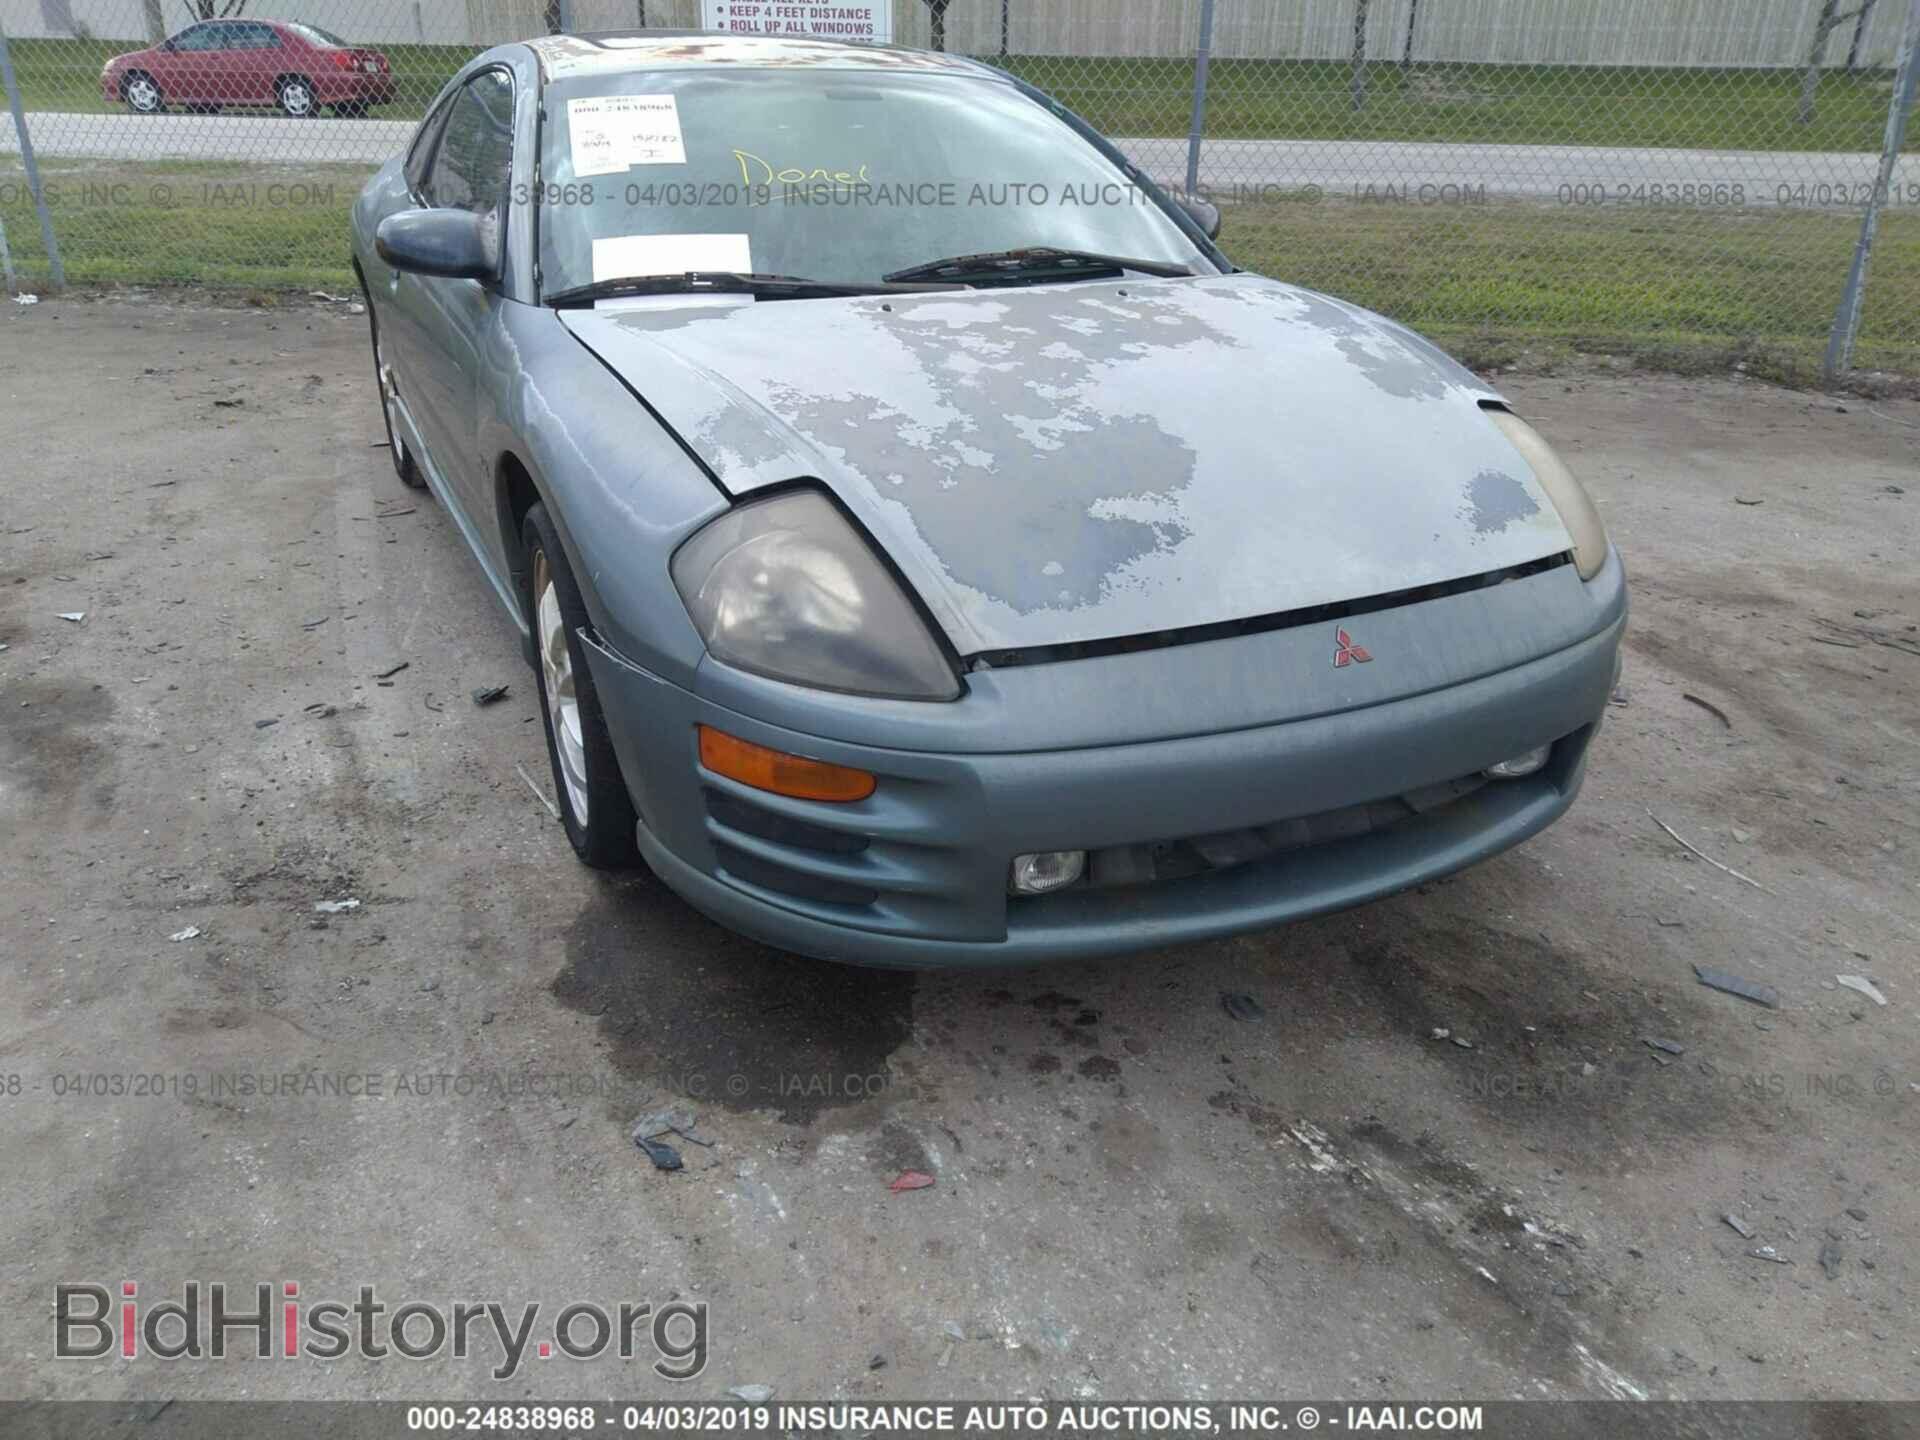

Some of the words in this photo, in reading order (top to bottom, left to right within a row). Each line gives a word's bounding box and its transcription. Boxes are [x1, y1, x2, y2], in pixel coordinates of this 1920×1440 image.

[729, 6, 760, 17] KEEP
[764, 6, 772, 17] 4
[775, 7, 806, 18] FEET
[810, 8, 872, 20] DISTANCE
[730, 19, 760, 32] ROLL
[765, 20, 781, 33] UP
[785, 21, 807, 33] ALL
[811, 22, 873, 35] WINDOWS
